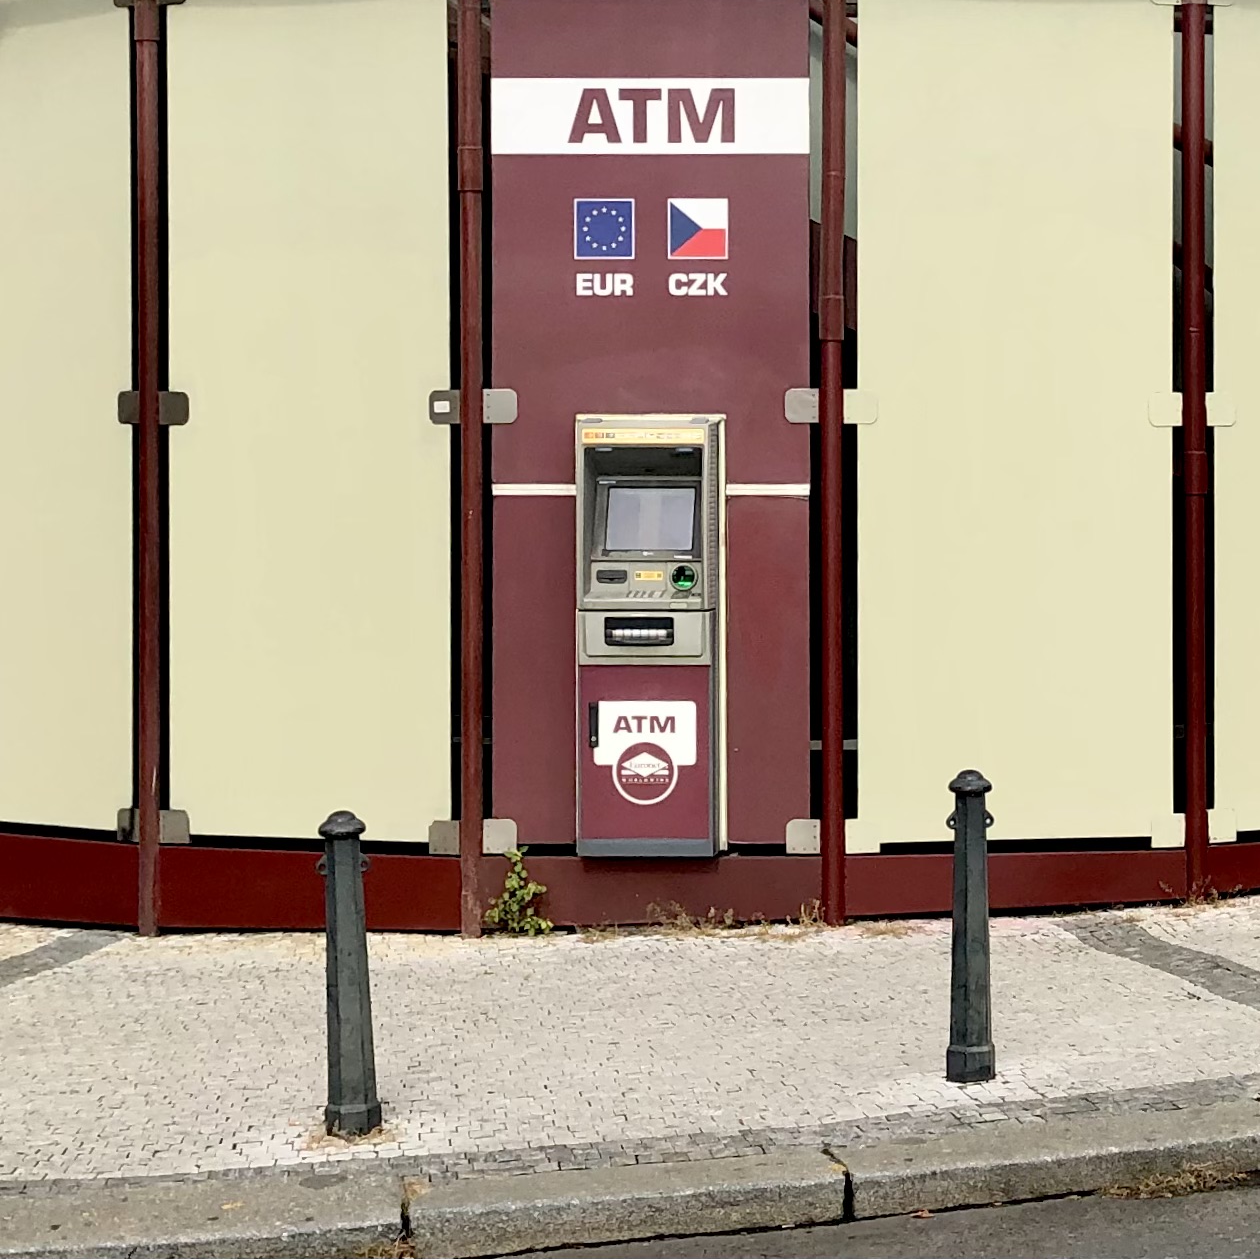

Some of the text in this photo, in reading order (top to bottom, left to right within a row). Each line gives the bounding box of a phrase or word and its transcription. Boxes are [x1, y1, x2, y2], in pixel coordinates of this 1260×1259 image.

[567, 88, 736, 143] ATM
[575, 272, 729, 296] EUR CZK
[612, 715, 677, 734] ATM
